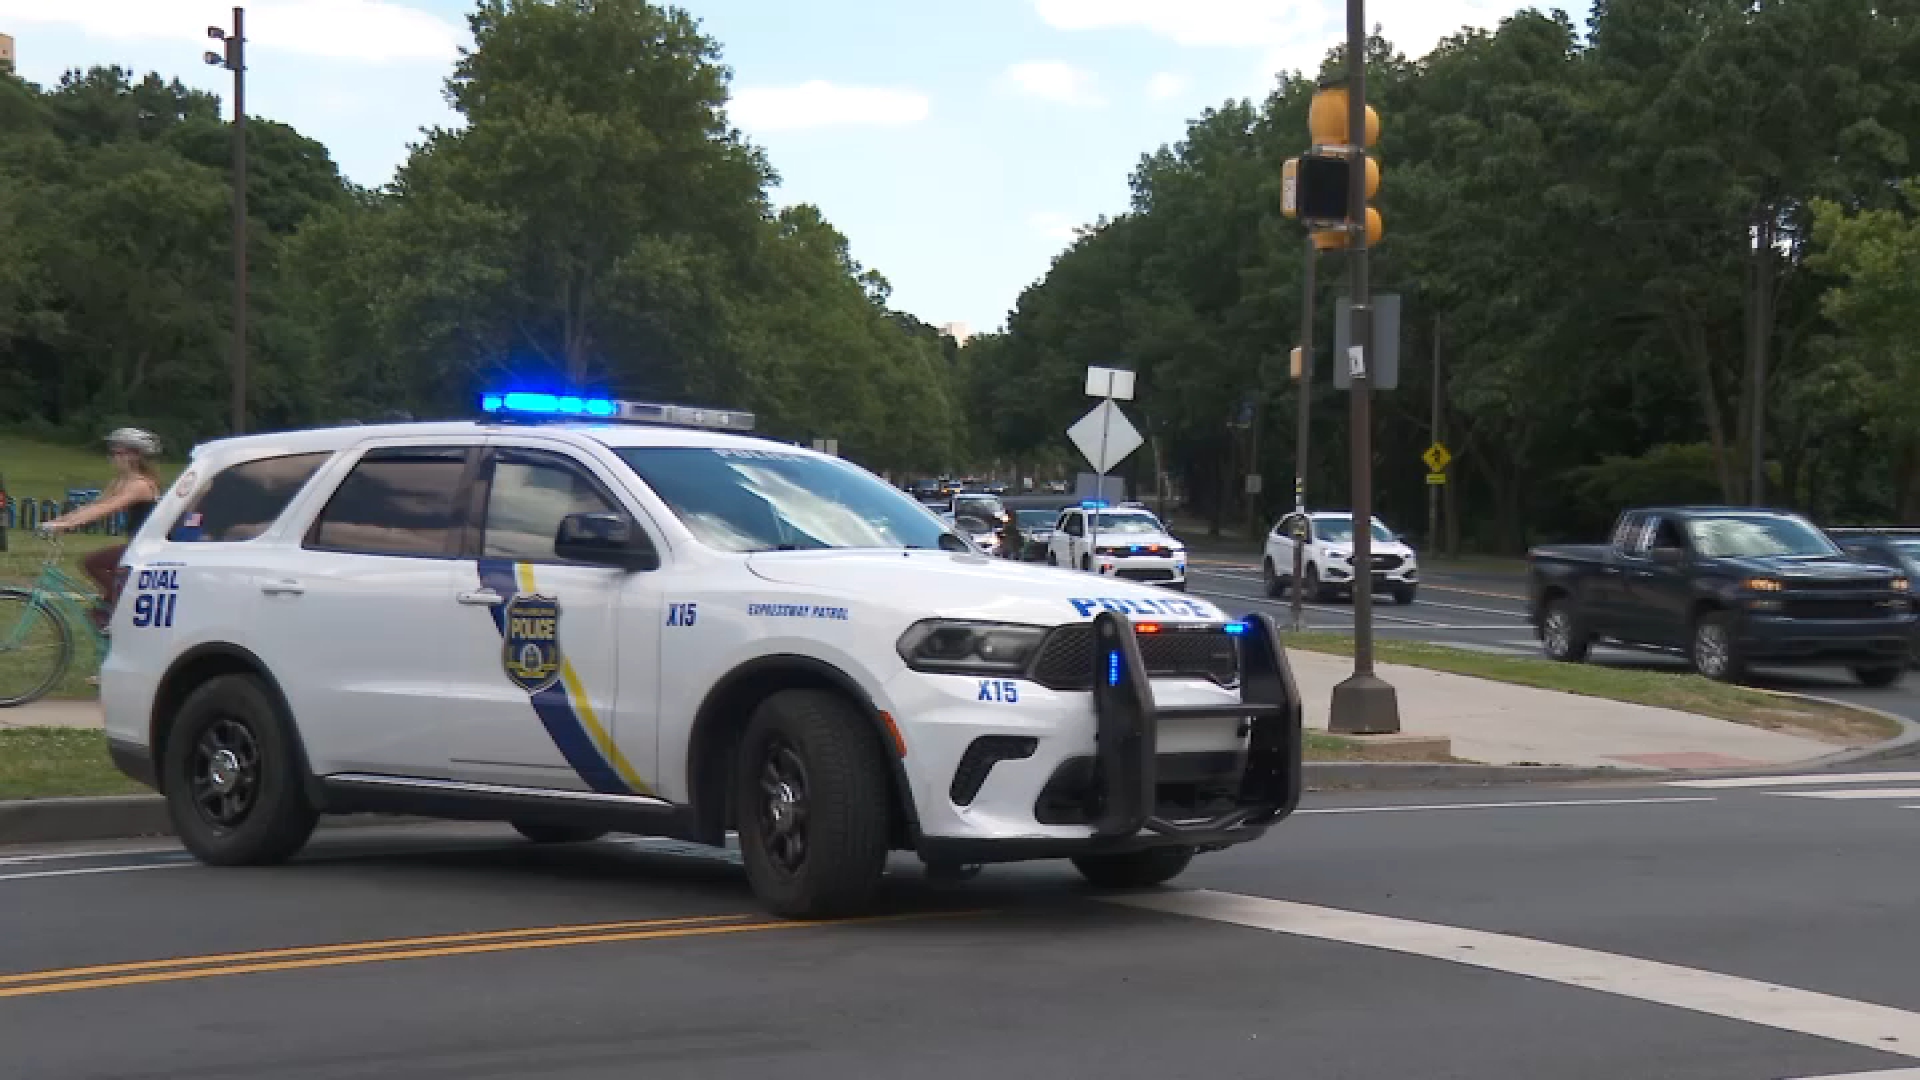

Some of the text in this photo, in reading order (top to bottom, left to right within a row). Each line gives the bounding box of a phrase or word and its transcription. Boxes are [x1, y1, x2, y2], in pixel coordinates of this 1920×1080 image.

[138, 570, 179, 590] DIAL
[133, 594, 176, 628] 911
[666, 604, 697, 626] X15
[812, 605, 848, 620] PATROL
[1067, 597, 1213, 618] POLICE
[511, 618, 555, 638] POLICE
[978, 680, 1017, 703] X15
